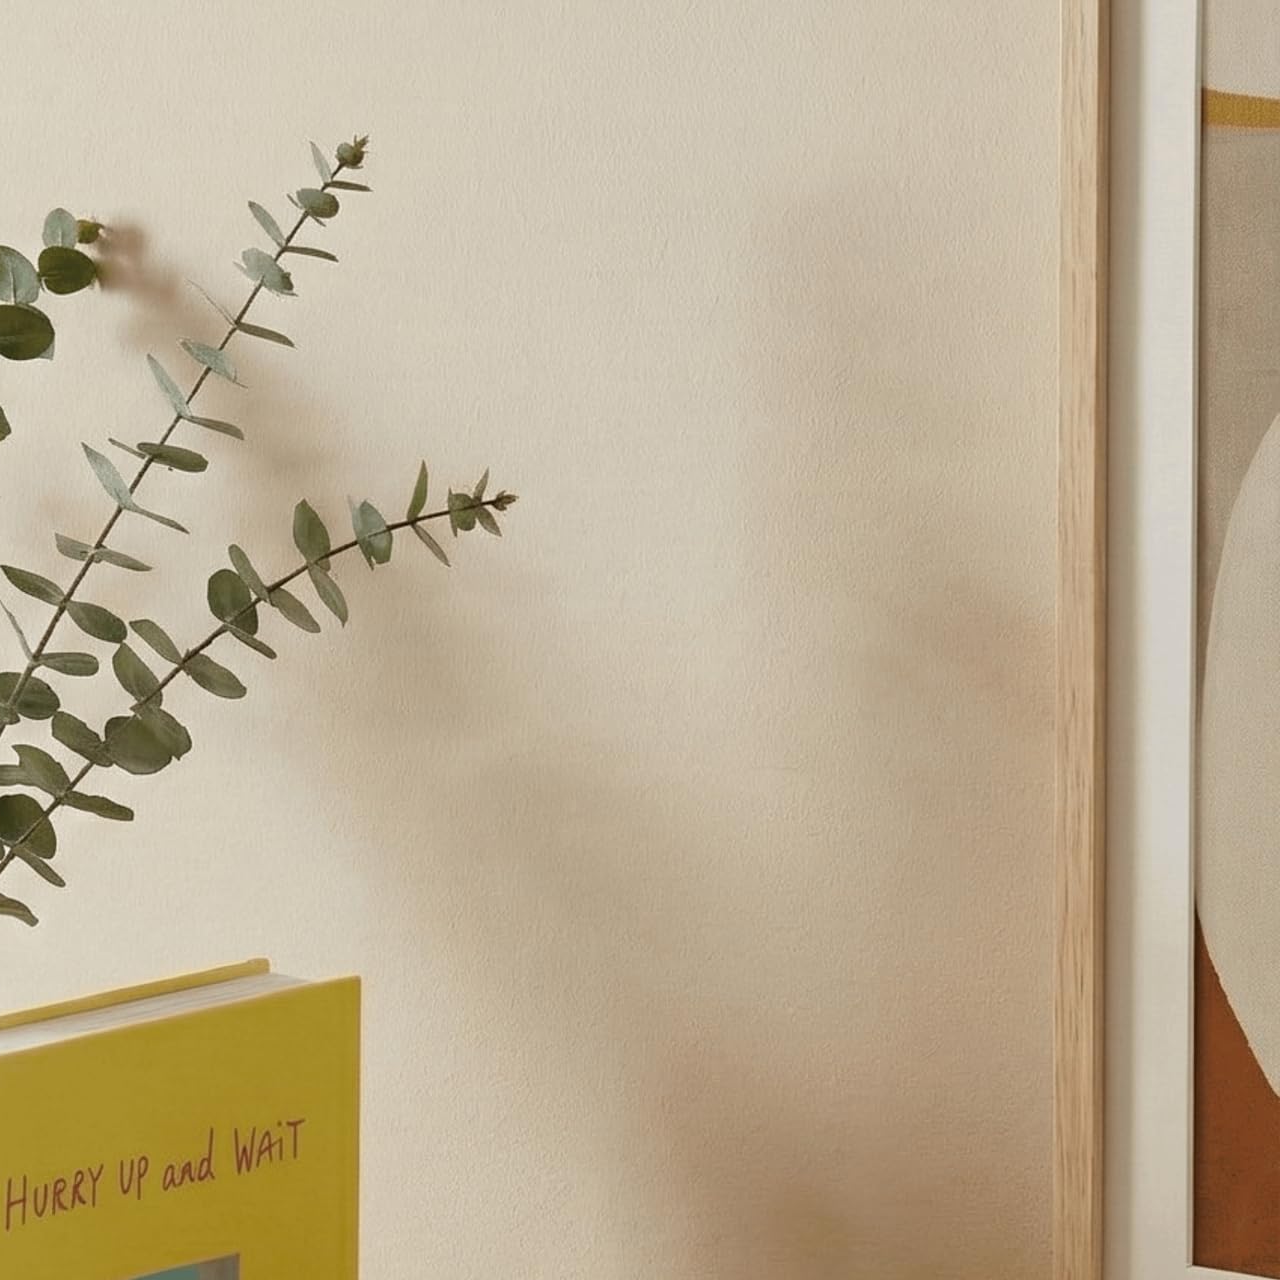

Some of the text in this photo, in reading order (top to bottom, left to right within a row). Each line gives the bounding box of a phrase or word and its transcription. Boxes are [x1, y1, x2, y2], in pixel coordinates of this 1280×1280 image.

[5, 1163, 104, 1232] HURRY
[119, 1155, 149, 1201] UP
[162, 1127, 216, 1192] and
